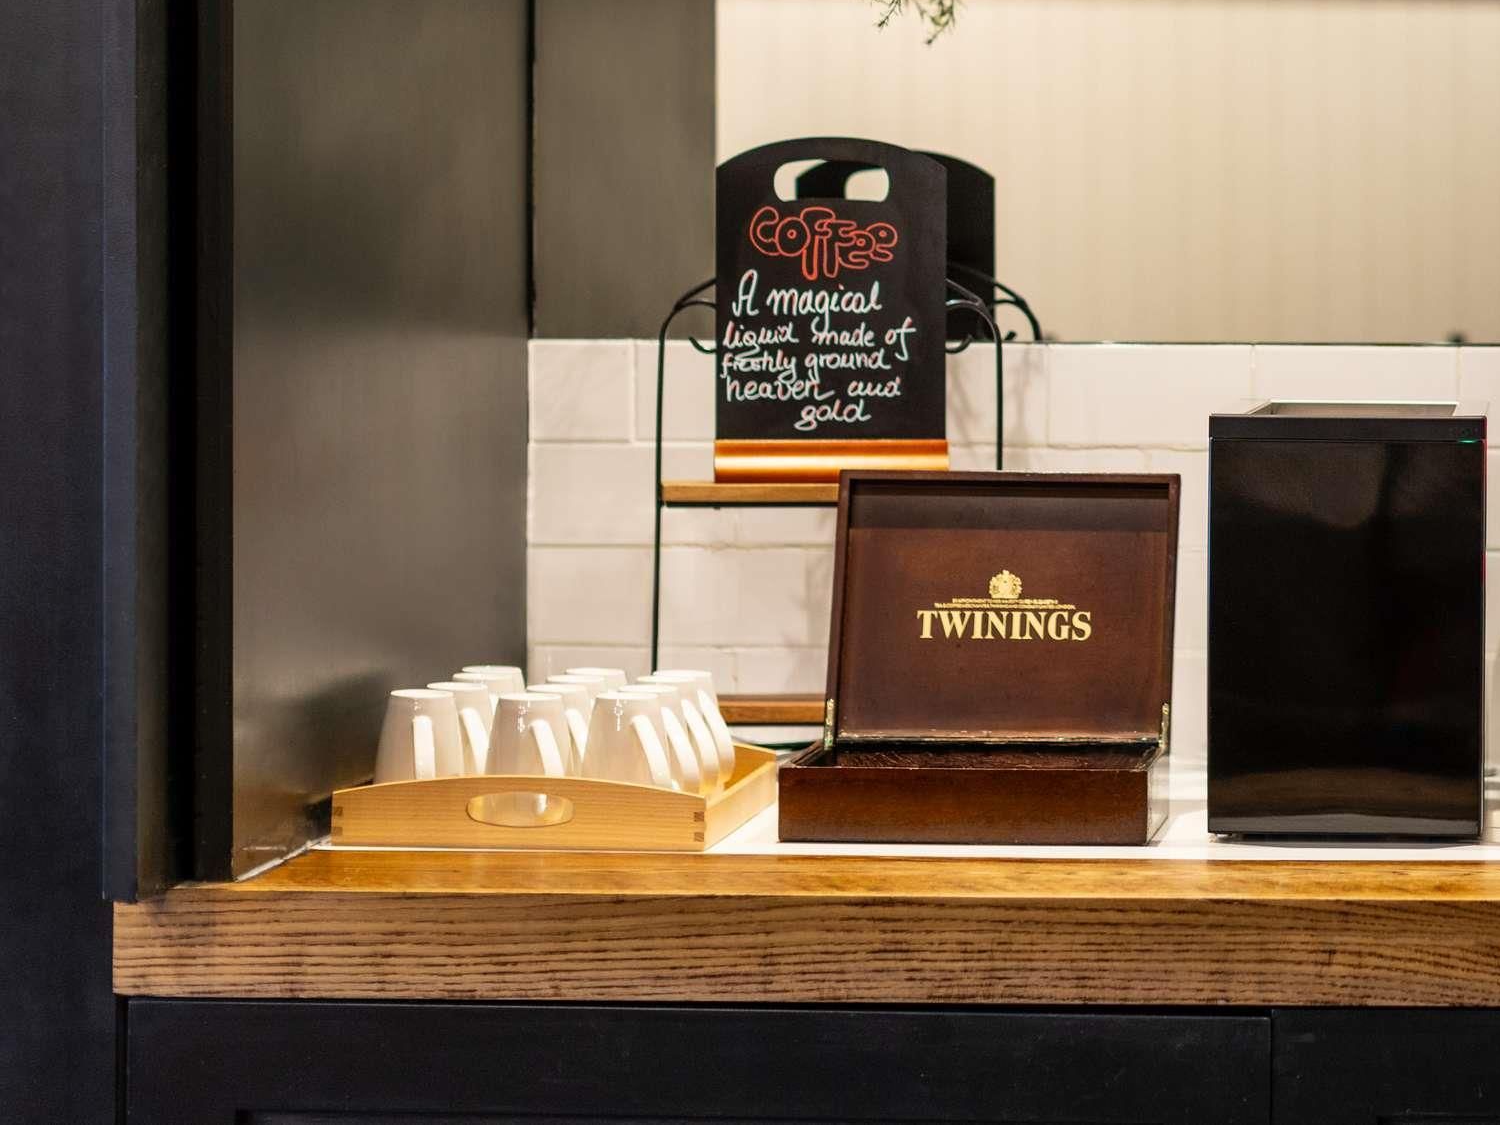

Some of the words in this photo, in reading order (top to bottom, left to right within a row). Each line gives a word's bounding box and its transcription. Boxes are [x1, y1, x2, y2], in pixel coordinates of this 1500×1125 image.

[732, 269, 759, 317] A
[766, 281, 882, 333] magical
[723, 320, 799, 354] liquid
[812, 327, 876, 347] made
[884, 317, 917, 361] of
[720, 351, 797, 383] freshly
[805, 348, 892, 382] ground
[726, 375, 834, 402] heaven
[848, 376, 902, 398] and
[794, 400, 871, 431] gold
[917, 610, 1092, 641] TWININGS
